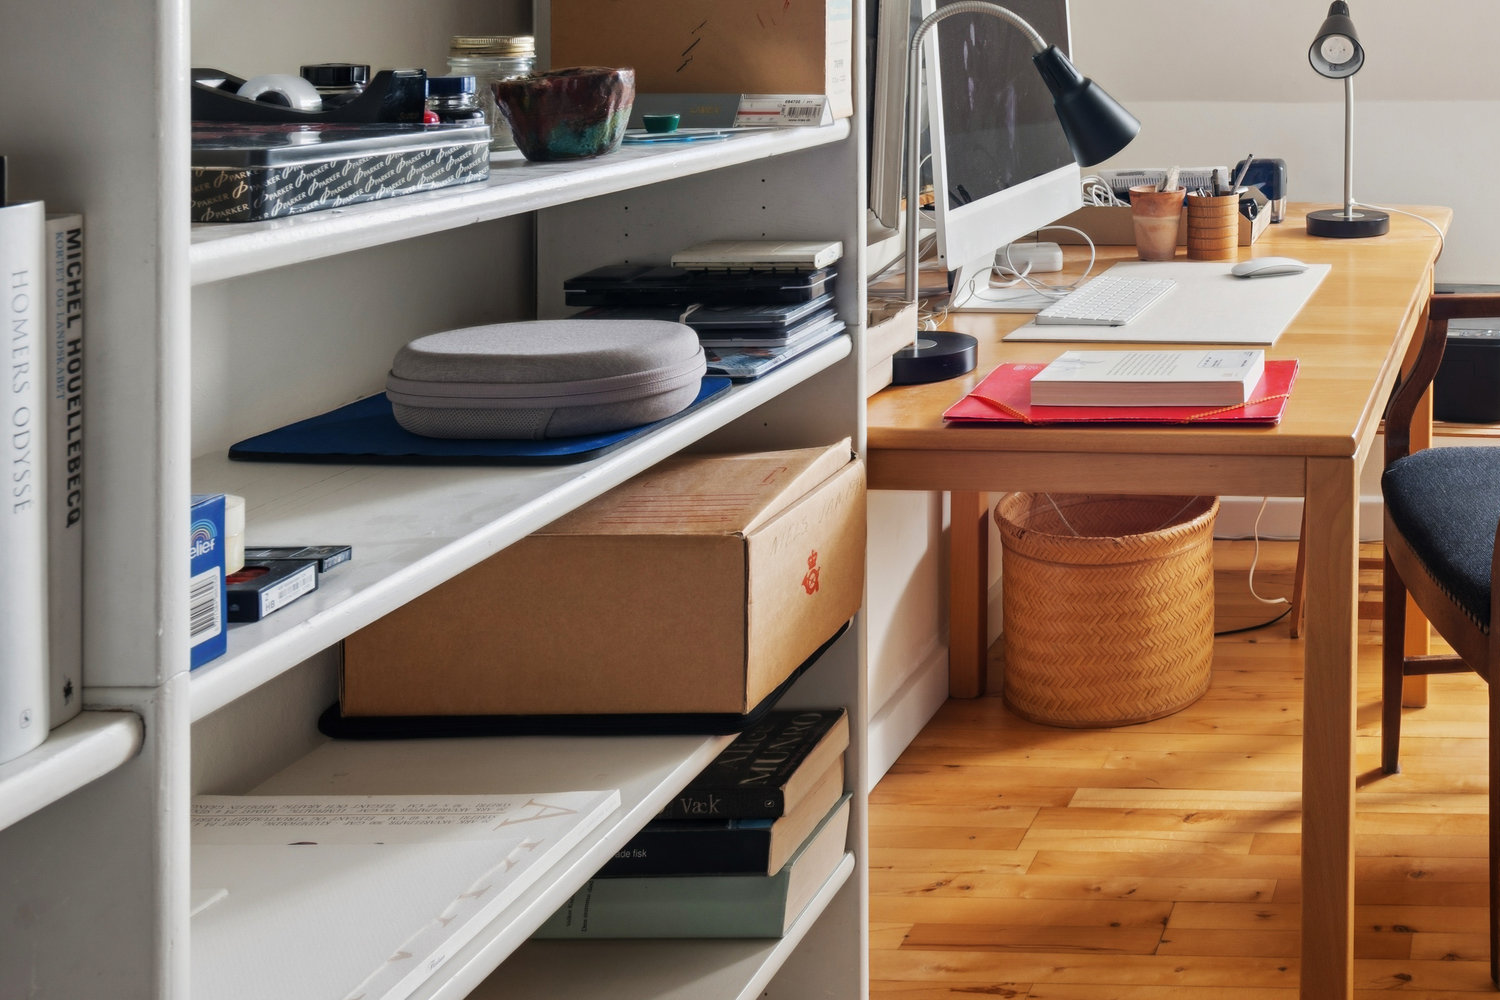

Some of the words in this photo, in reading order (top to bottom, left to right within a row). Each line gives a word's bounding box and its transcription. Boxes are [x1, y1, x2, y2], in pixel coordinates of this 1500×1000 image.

[306, 163, 328, 179] PARKER
[363, 161, 384, 177] PARKER
[375, 168, 395, 185] PARKER
[318, 172, 340, 188] PARKER
[269, 183, 294, 200] PARKER
[282, 192, 306, 209] PARKER
[215, 203, 249, 219] PARKER
[55, 231, 65, 285] KORTET
[66, 227, 82, 329] MICHEL
[56, 288, 66, 307] OG
[11, 268, 31, 395] HOMERS
[55, 309, 67, 401] LANDSKABET
[65, 339, 82, 529] HOUELLEBECQ
[11, 406, 34, 515] ODYSSÉ
[265, 600, 276, 612] HB
[740, 711, 823, 786] MUNRO
[680, 794, 721, 815] Væk
[632, 848, 648, 859] fisk
